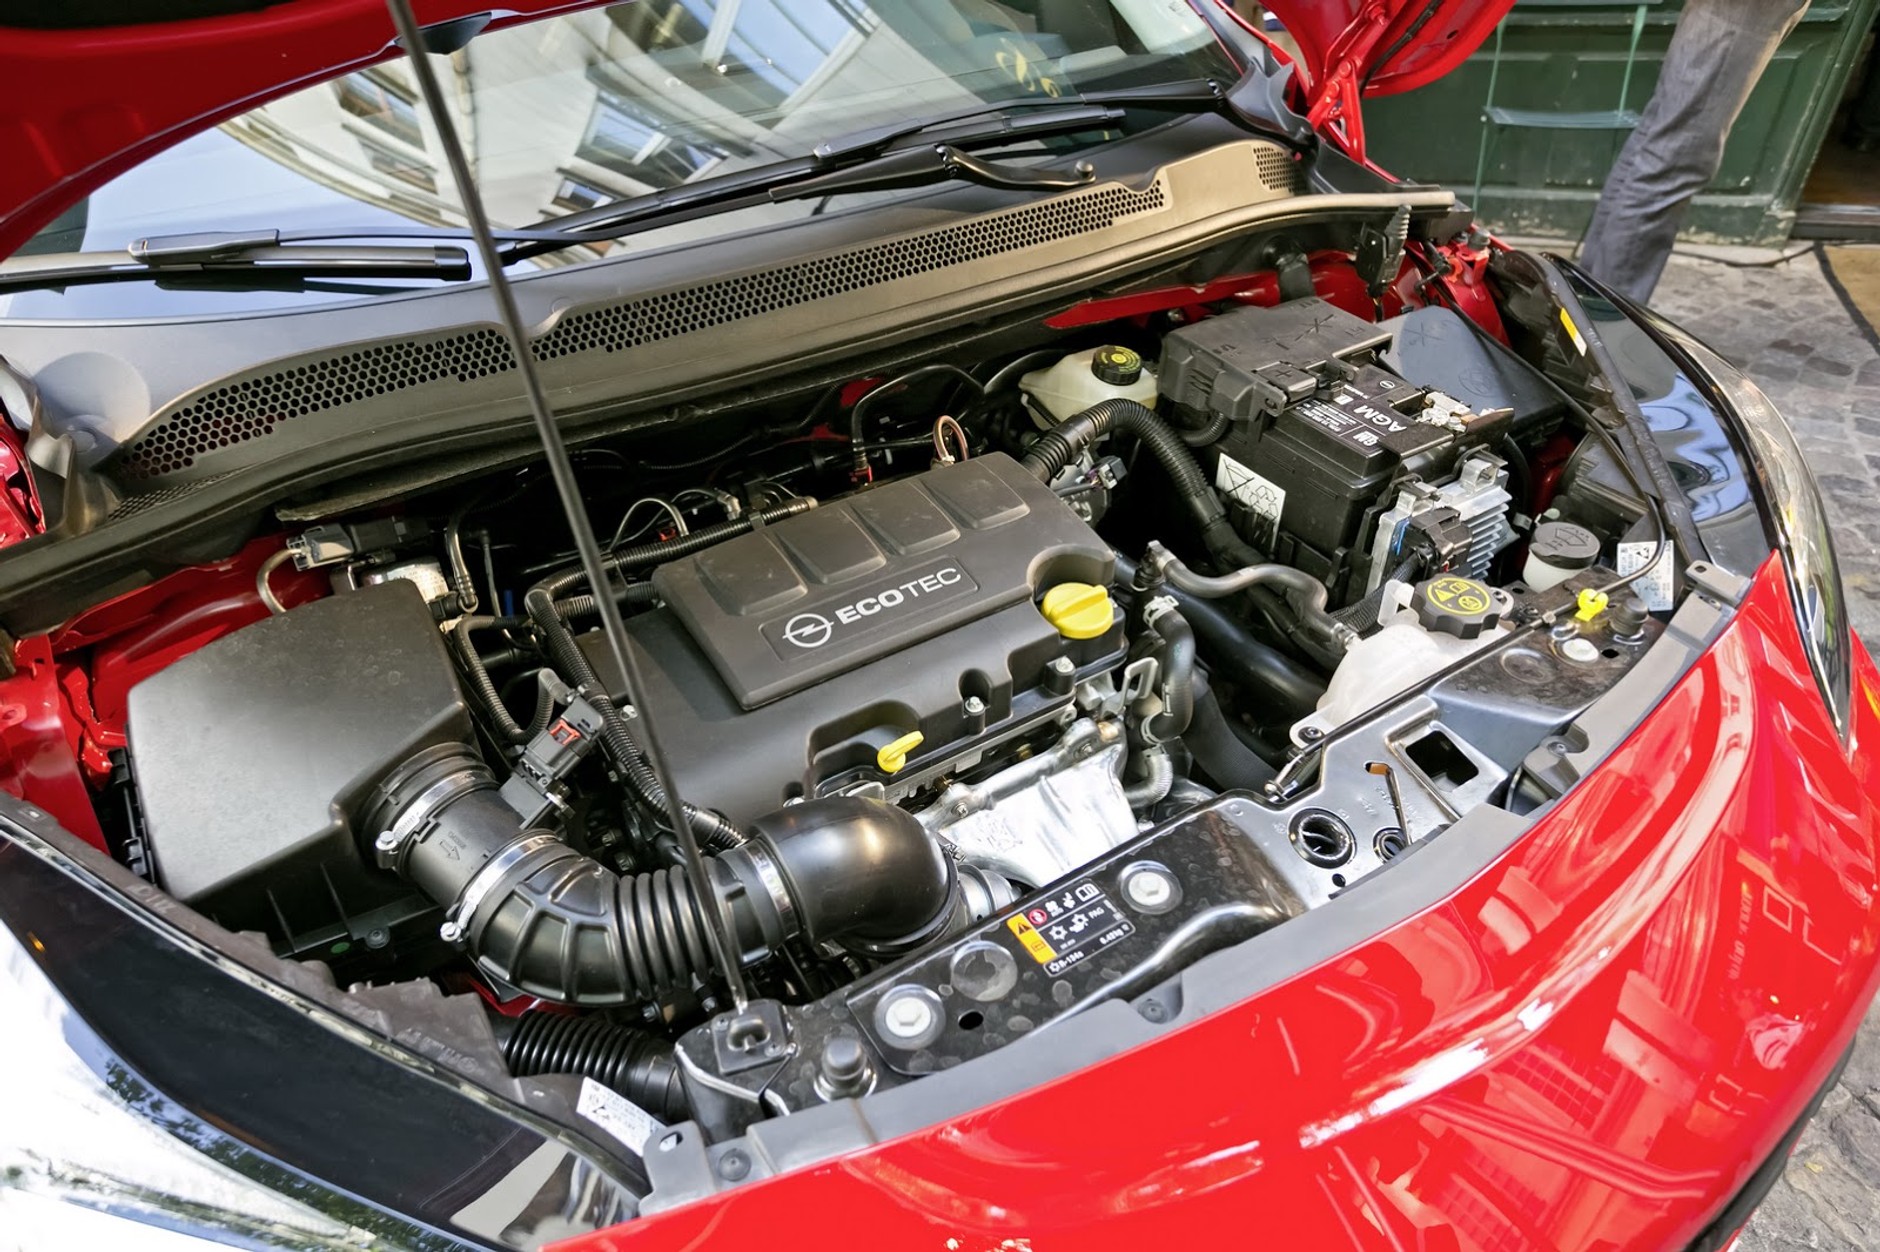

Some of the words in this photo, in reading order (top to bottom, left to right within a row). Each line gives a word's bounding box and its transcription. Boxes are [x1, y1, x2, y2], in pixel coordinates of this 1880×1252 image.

[1353, 405, 1407, 432] AGM
[1353, 431, 1379, 446] GM
[835, 567, 962, 625] ECOTEC
